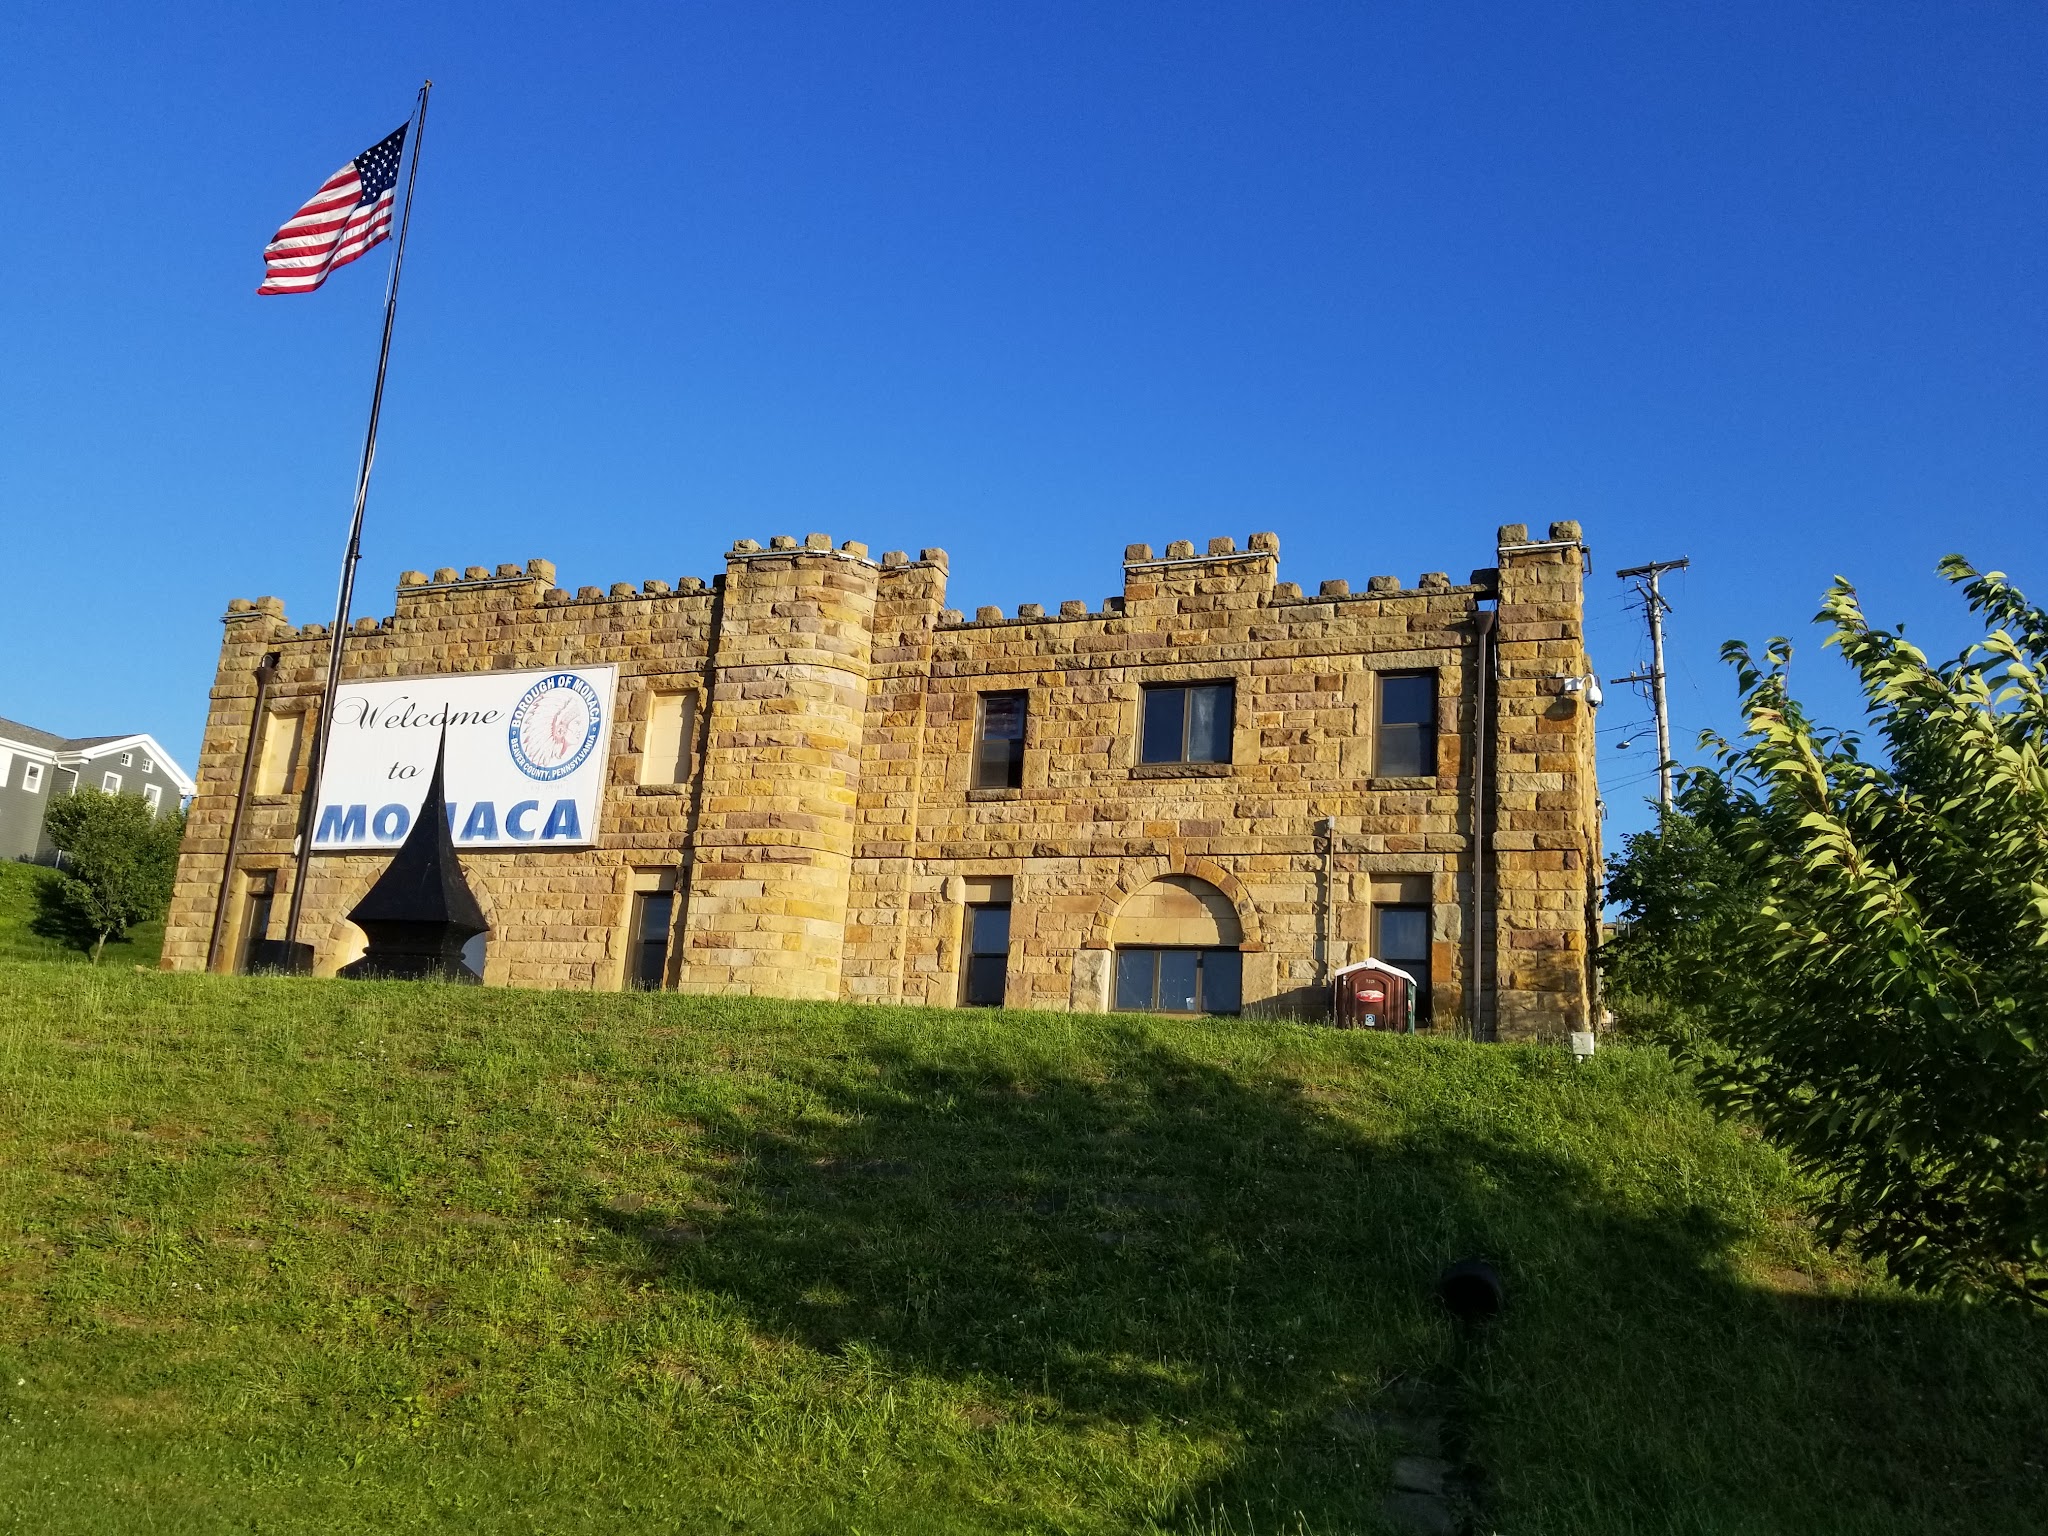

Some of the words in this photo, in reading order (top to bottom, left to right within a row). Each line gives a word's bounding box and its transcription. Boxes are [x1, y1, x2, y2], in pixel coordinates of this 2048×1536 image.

[332, 696, 505, 729] Welcome
[512, 677, 555, 727] BOROUGH
[558, 675, 573, 687] OF
[572, 679, 600, 725] MONACA
[388, 761, 424, 779] to
[511, 738, 524, 766] BEAVER
[552, 735, 595, 778] PENNSYLVANIA
